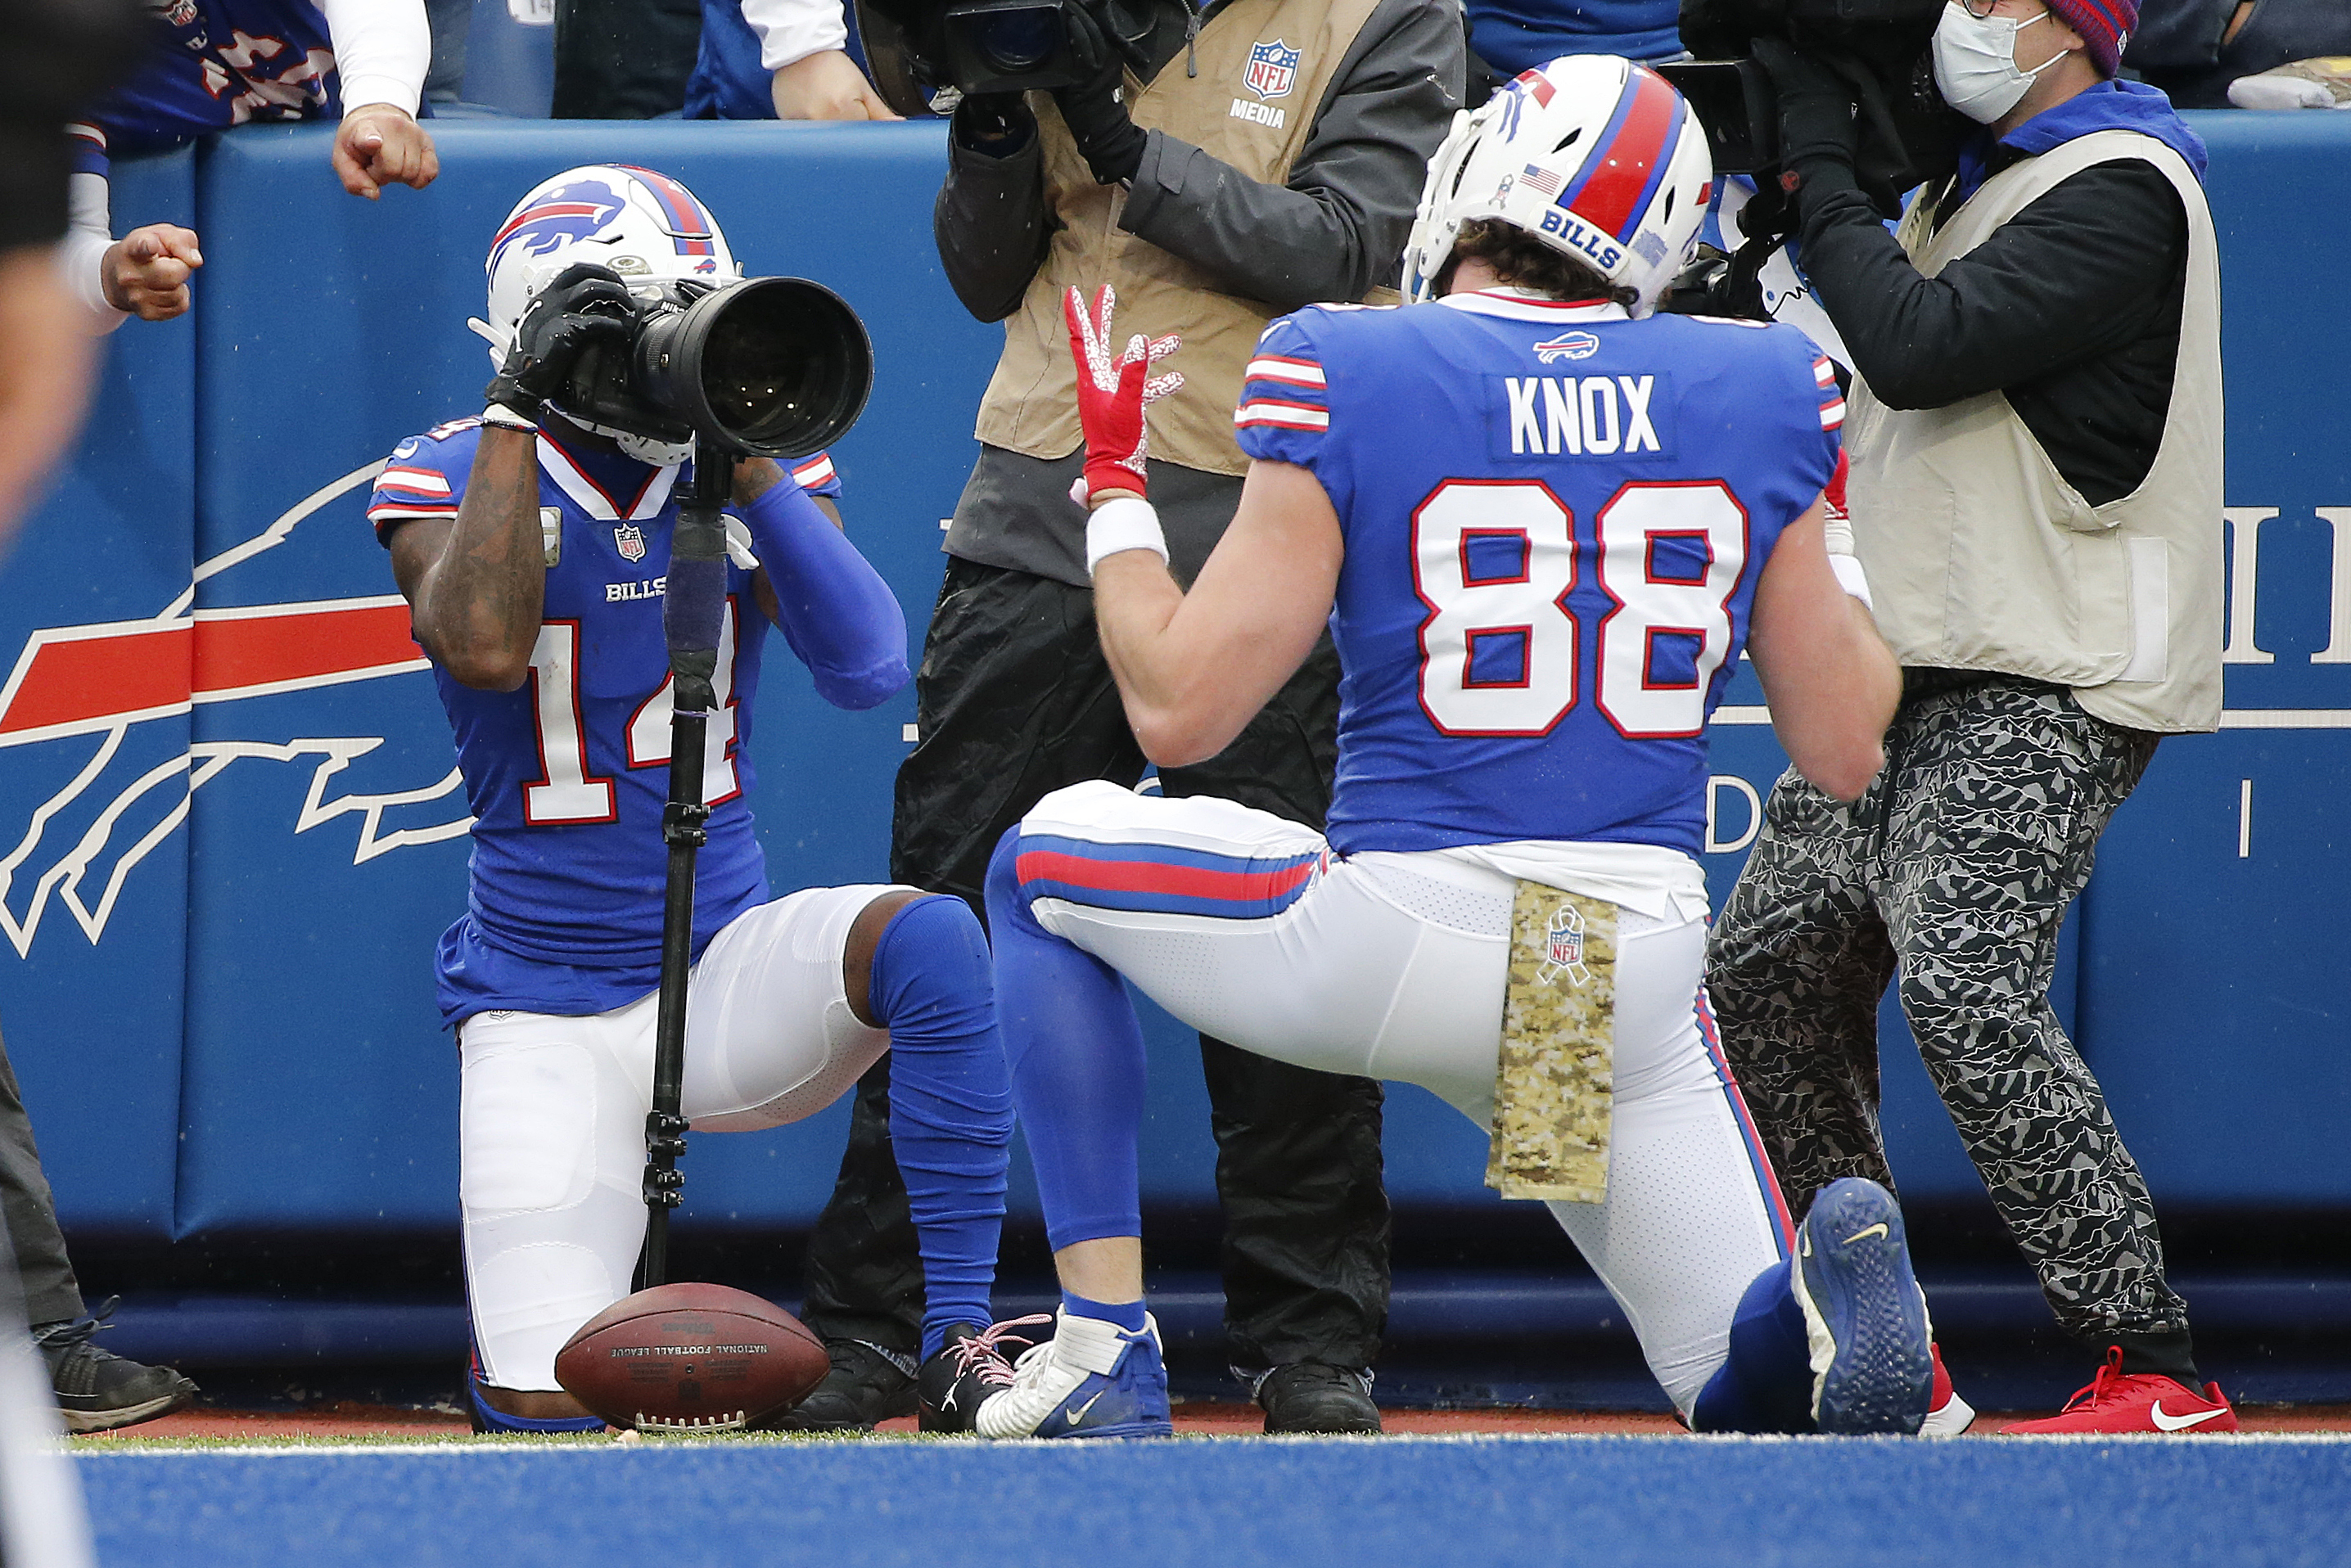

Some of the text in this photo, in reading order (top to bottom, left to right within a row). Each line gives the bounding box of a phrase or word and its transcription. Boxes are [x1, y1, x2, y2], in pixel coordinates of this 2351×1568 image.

[1248, 61, 1287, 92] NFL
[1230, 97, 1286, 129] MEDIA
[1539, 209, 1622, 270] BILLS
[1505, 374, 1662, 456] KNOX
[621, 540, 642, 556] NFL
[605, 575, 668, 603] BILLS
[1410, 477, 1750, 741] 88
[522, 596, 741, 826] 14
[1552, 943, 1578, 962] NFL
[611, 1343, 768, 1358] NATIONAL FOOTBALL LEAGUE
